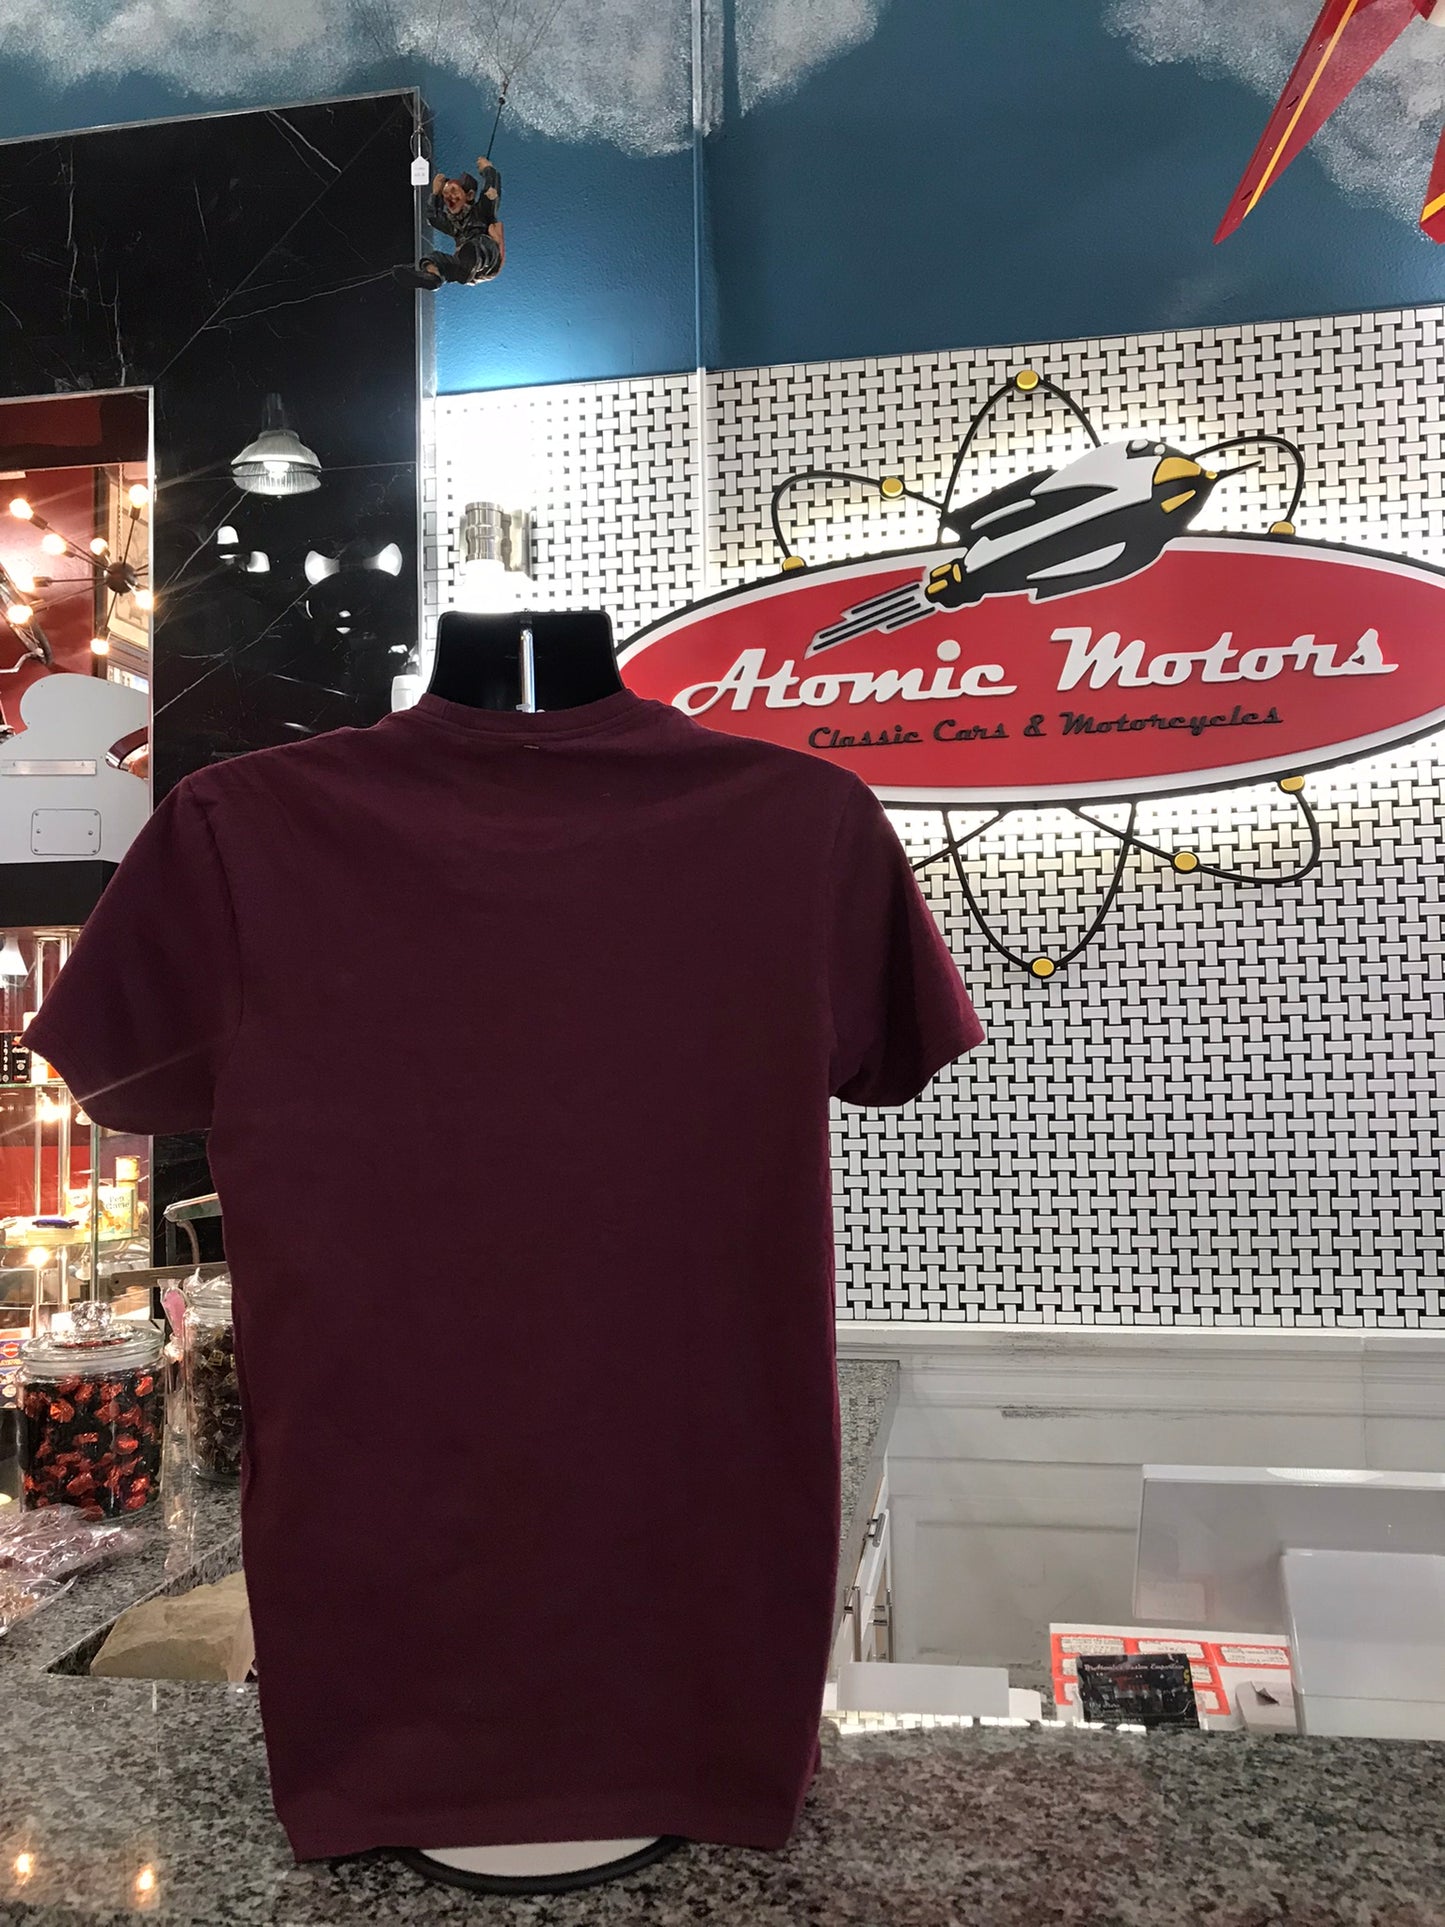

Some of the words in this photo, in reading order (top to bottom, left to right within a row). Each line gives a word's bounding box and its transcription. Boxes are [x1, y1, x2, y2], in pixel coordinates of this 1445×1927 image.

[671, 639, 1018, 716] Atomic
[1050, 627, 1399, 691] Motors
[808, 725, 923, 749] Classic
[933, 719, 1010, 742] Cars
[1024, 714, 1047, 737] &
[1059, 705, 1284, 736] Motorcycles
